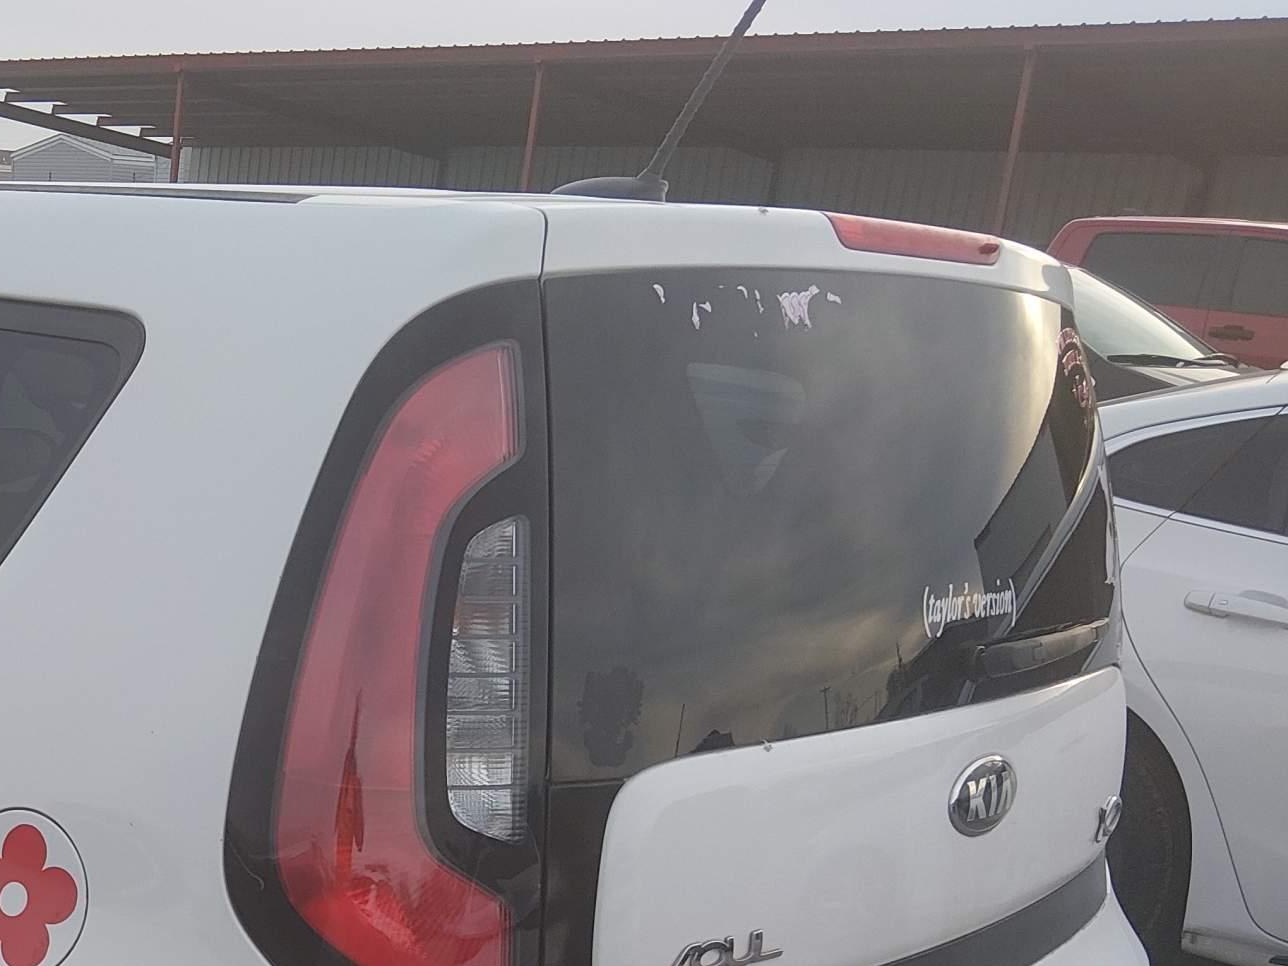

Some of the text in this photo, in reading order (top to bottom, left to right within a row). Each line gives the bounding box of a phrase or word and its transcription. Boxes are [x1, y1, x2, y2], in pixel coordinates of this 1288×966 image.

[923, 578, 1017, 638] (taylor's version)
[966, 770, 1014, 823] KIA
